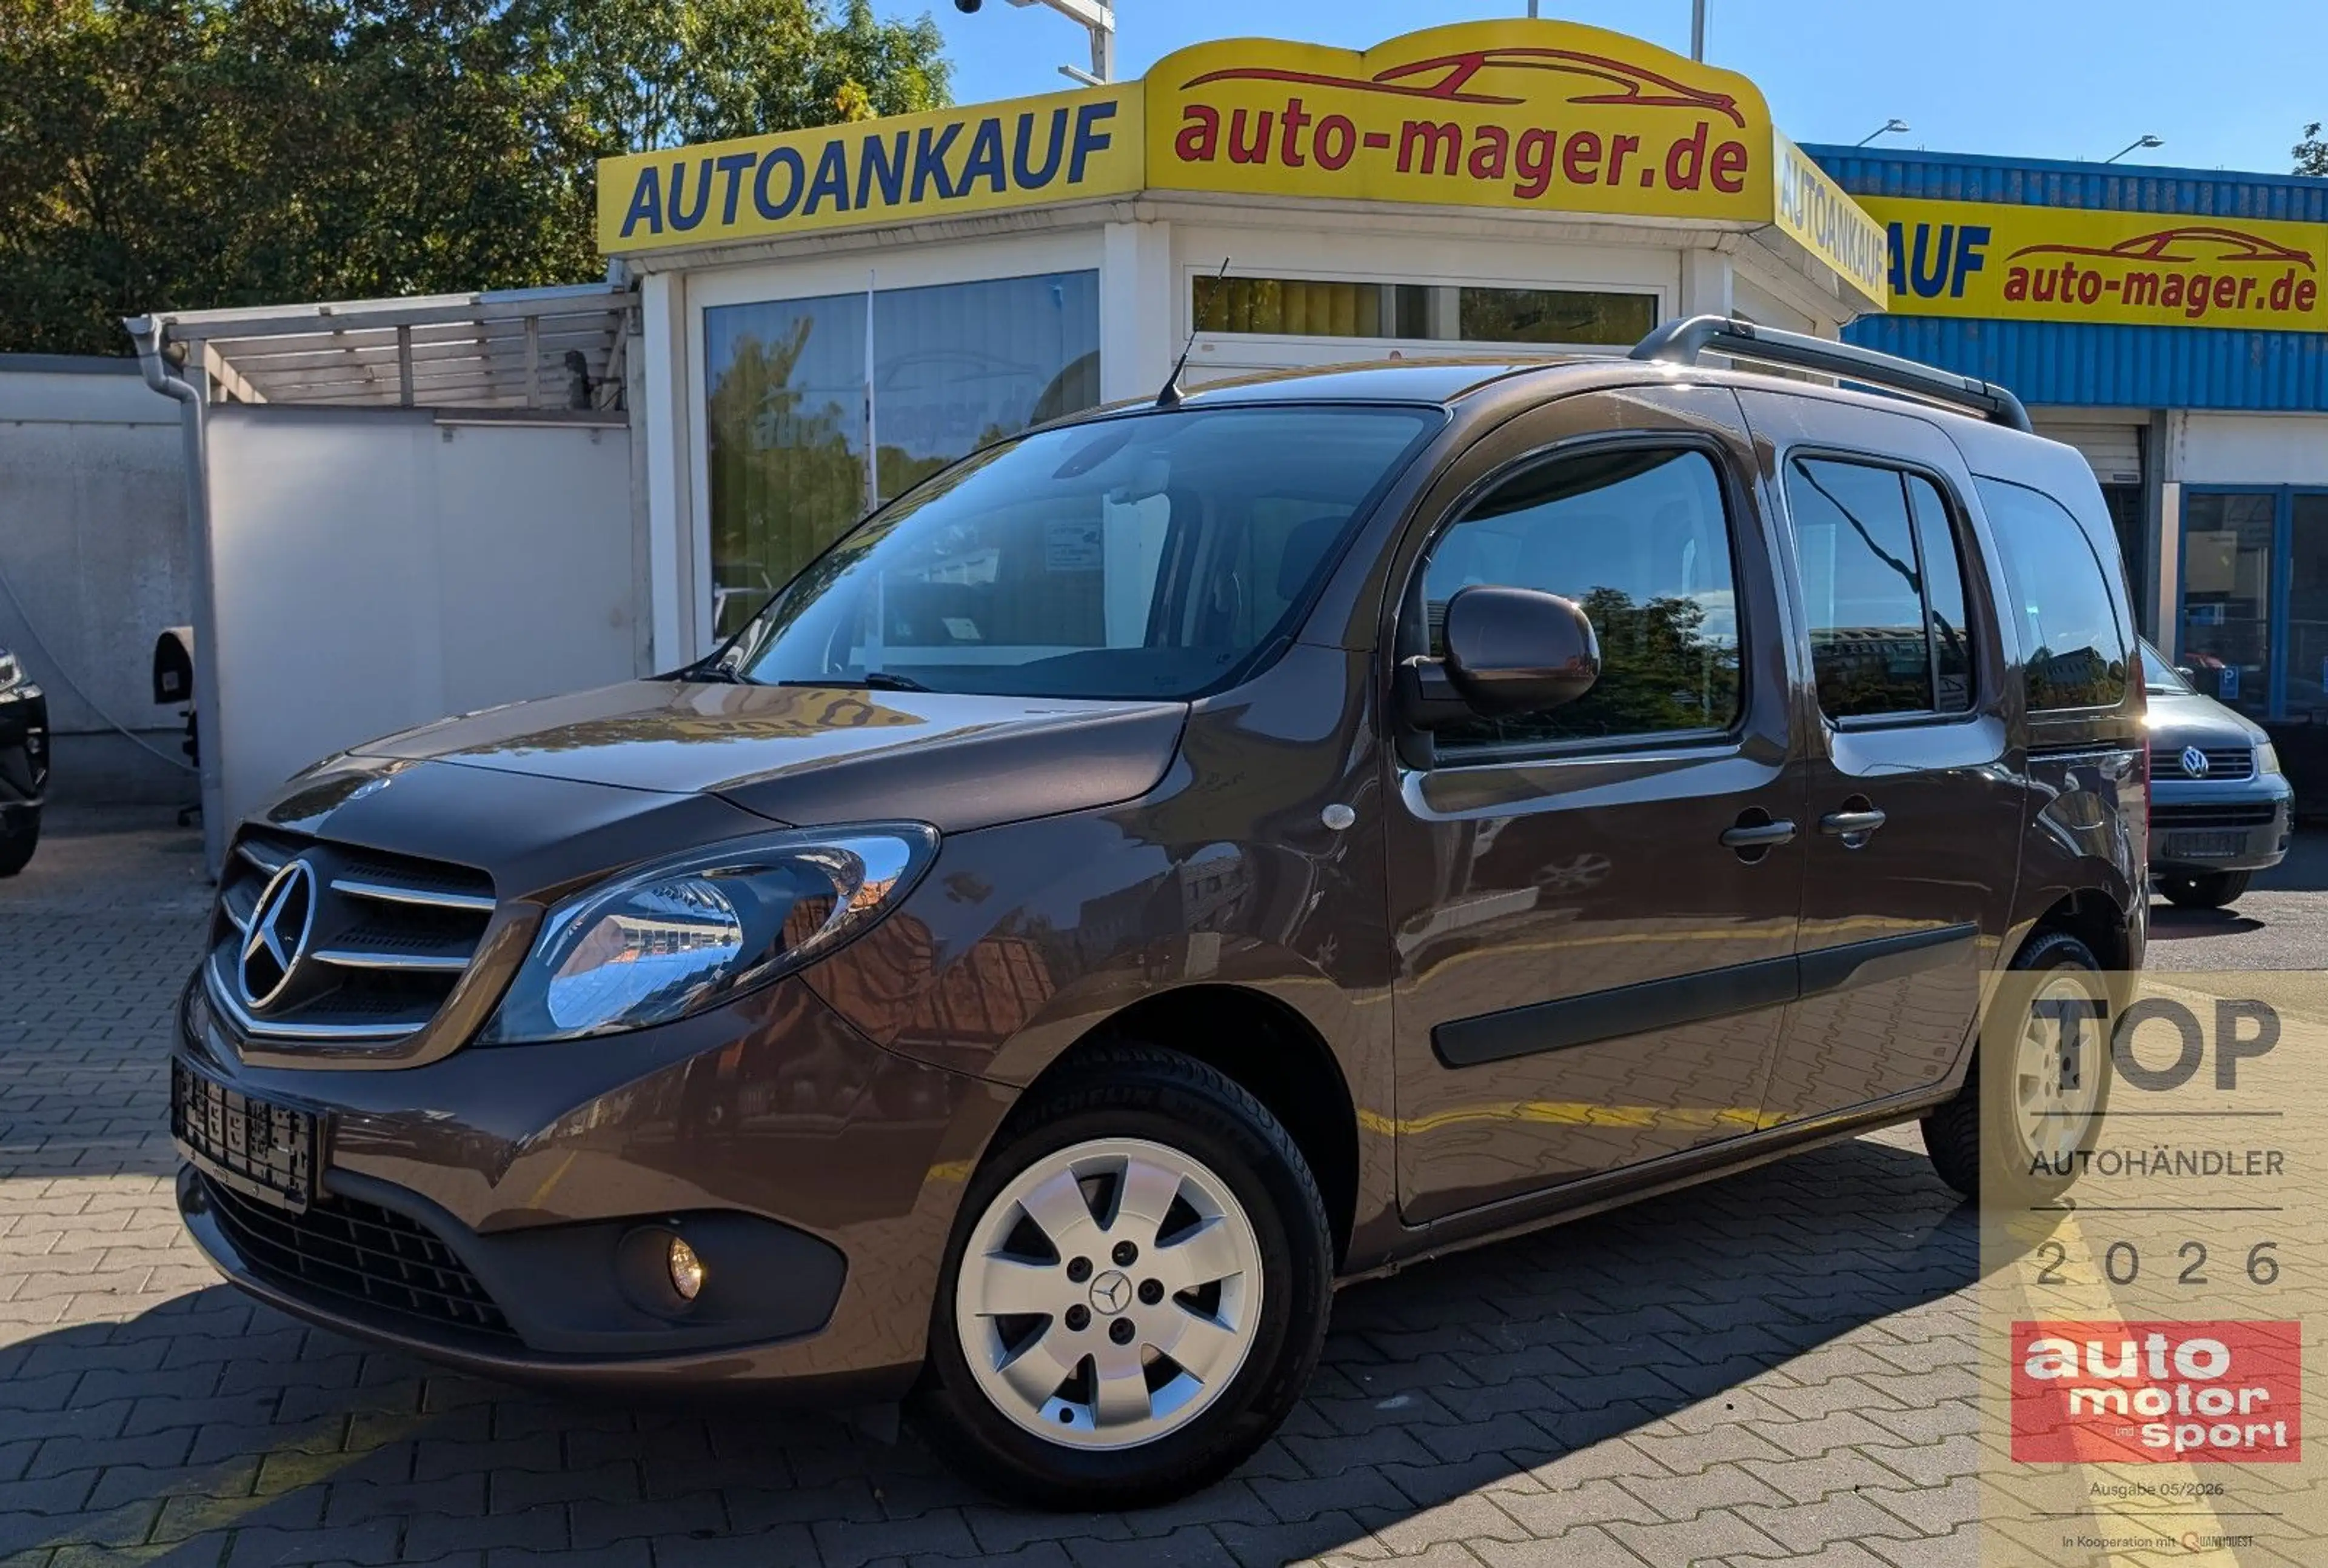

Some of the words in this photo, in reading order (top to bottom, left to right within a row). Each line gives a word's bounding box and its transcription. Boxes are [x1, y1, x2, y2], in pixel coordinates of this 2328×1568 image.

[620, 101, 1117, 238] AUTOANKAUF
[1175, 98, 1747, 199] auto-mager.de
[1781, 152, 1883, 292] AUTOANKAUF
[2004, 262, 2316, 318] auto-mager.de
